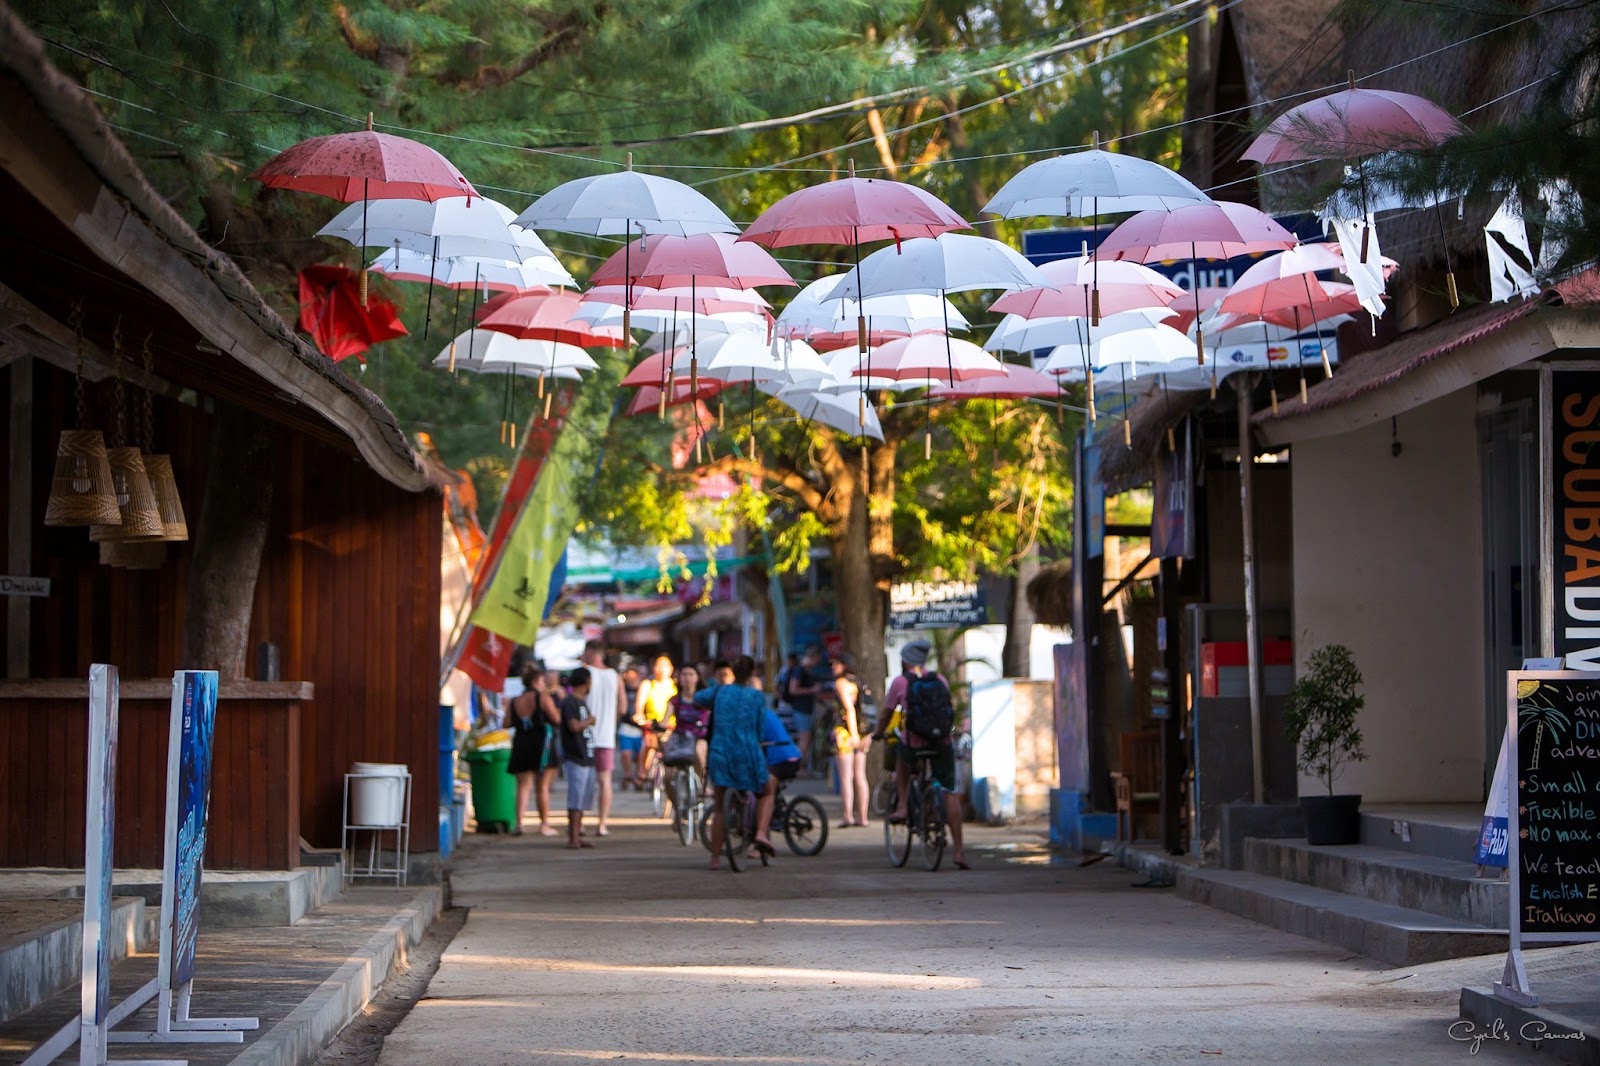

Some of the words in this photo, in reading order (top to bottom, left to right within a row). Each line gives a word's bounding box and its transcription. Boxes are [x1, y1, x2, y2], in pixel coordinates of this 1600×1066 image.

[1576, 720, 1600, 739] DI
[1528, 770, 1586, 794] Small
[1527, 800, 1596, 821] Flexible
[1556, 829, 1592, 842] max.
[1523, 853, 1548, 874] We
[1530, 882, 1583, 900] English
[1525, 905, 1596, 925] Italiano
